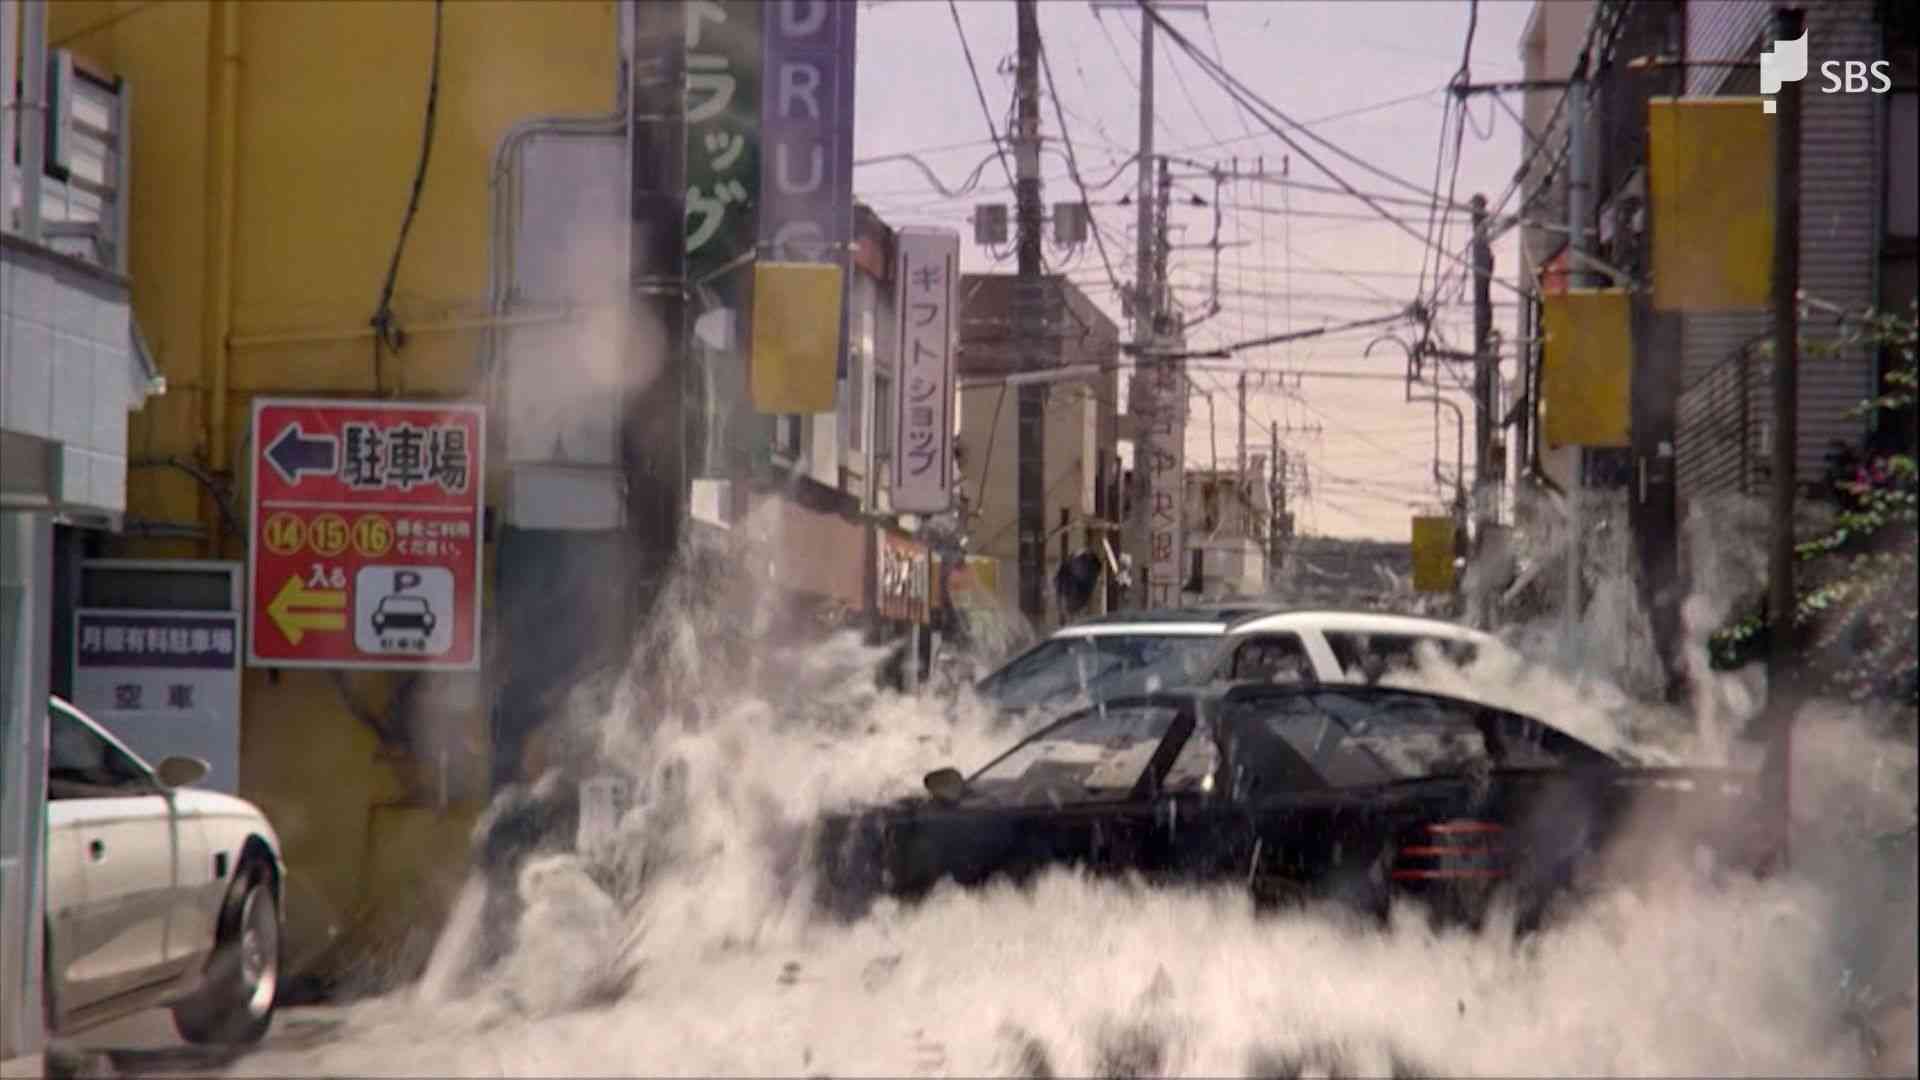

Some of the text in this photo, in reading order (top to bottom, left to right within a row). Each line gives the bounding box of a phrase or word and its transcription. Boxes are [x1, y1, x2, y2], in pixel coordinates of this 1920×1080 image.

[909, 263, 942, 477] ギフトショップ
[344, 424, 468, 490] 駐車場
[269, 519, 390, 552] 14 15 16
[393, 570, 421, 592] P
